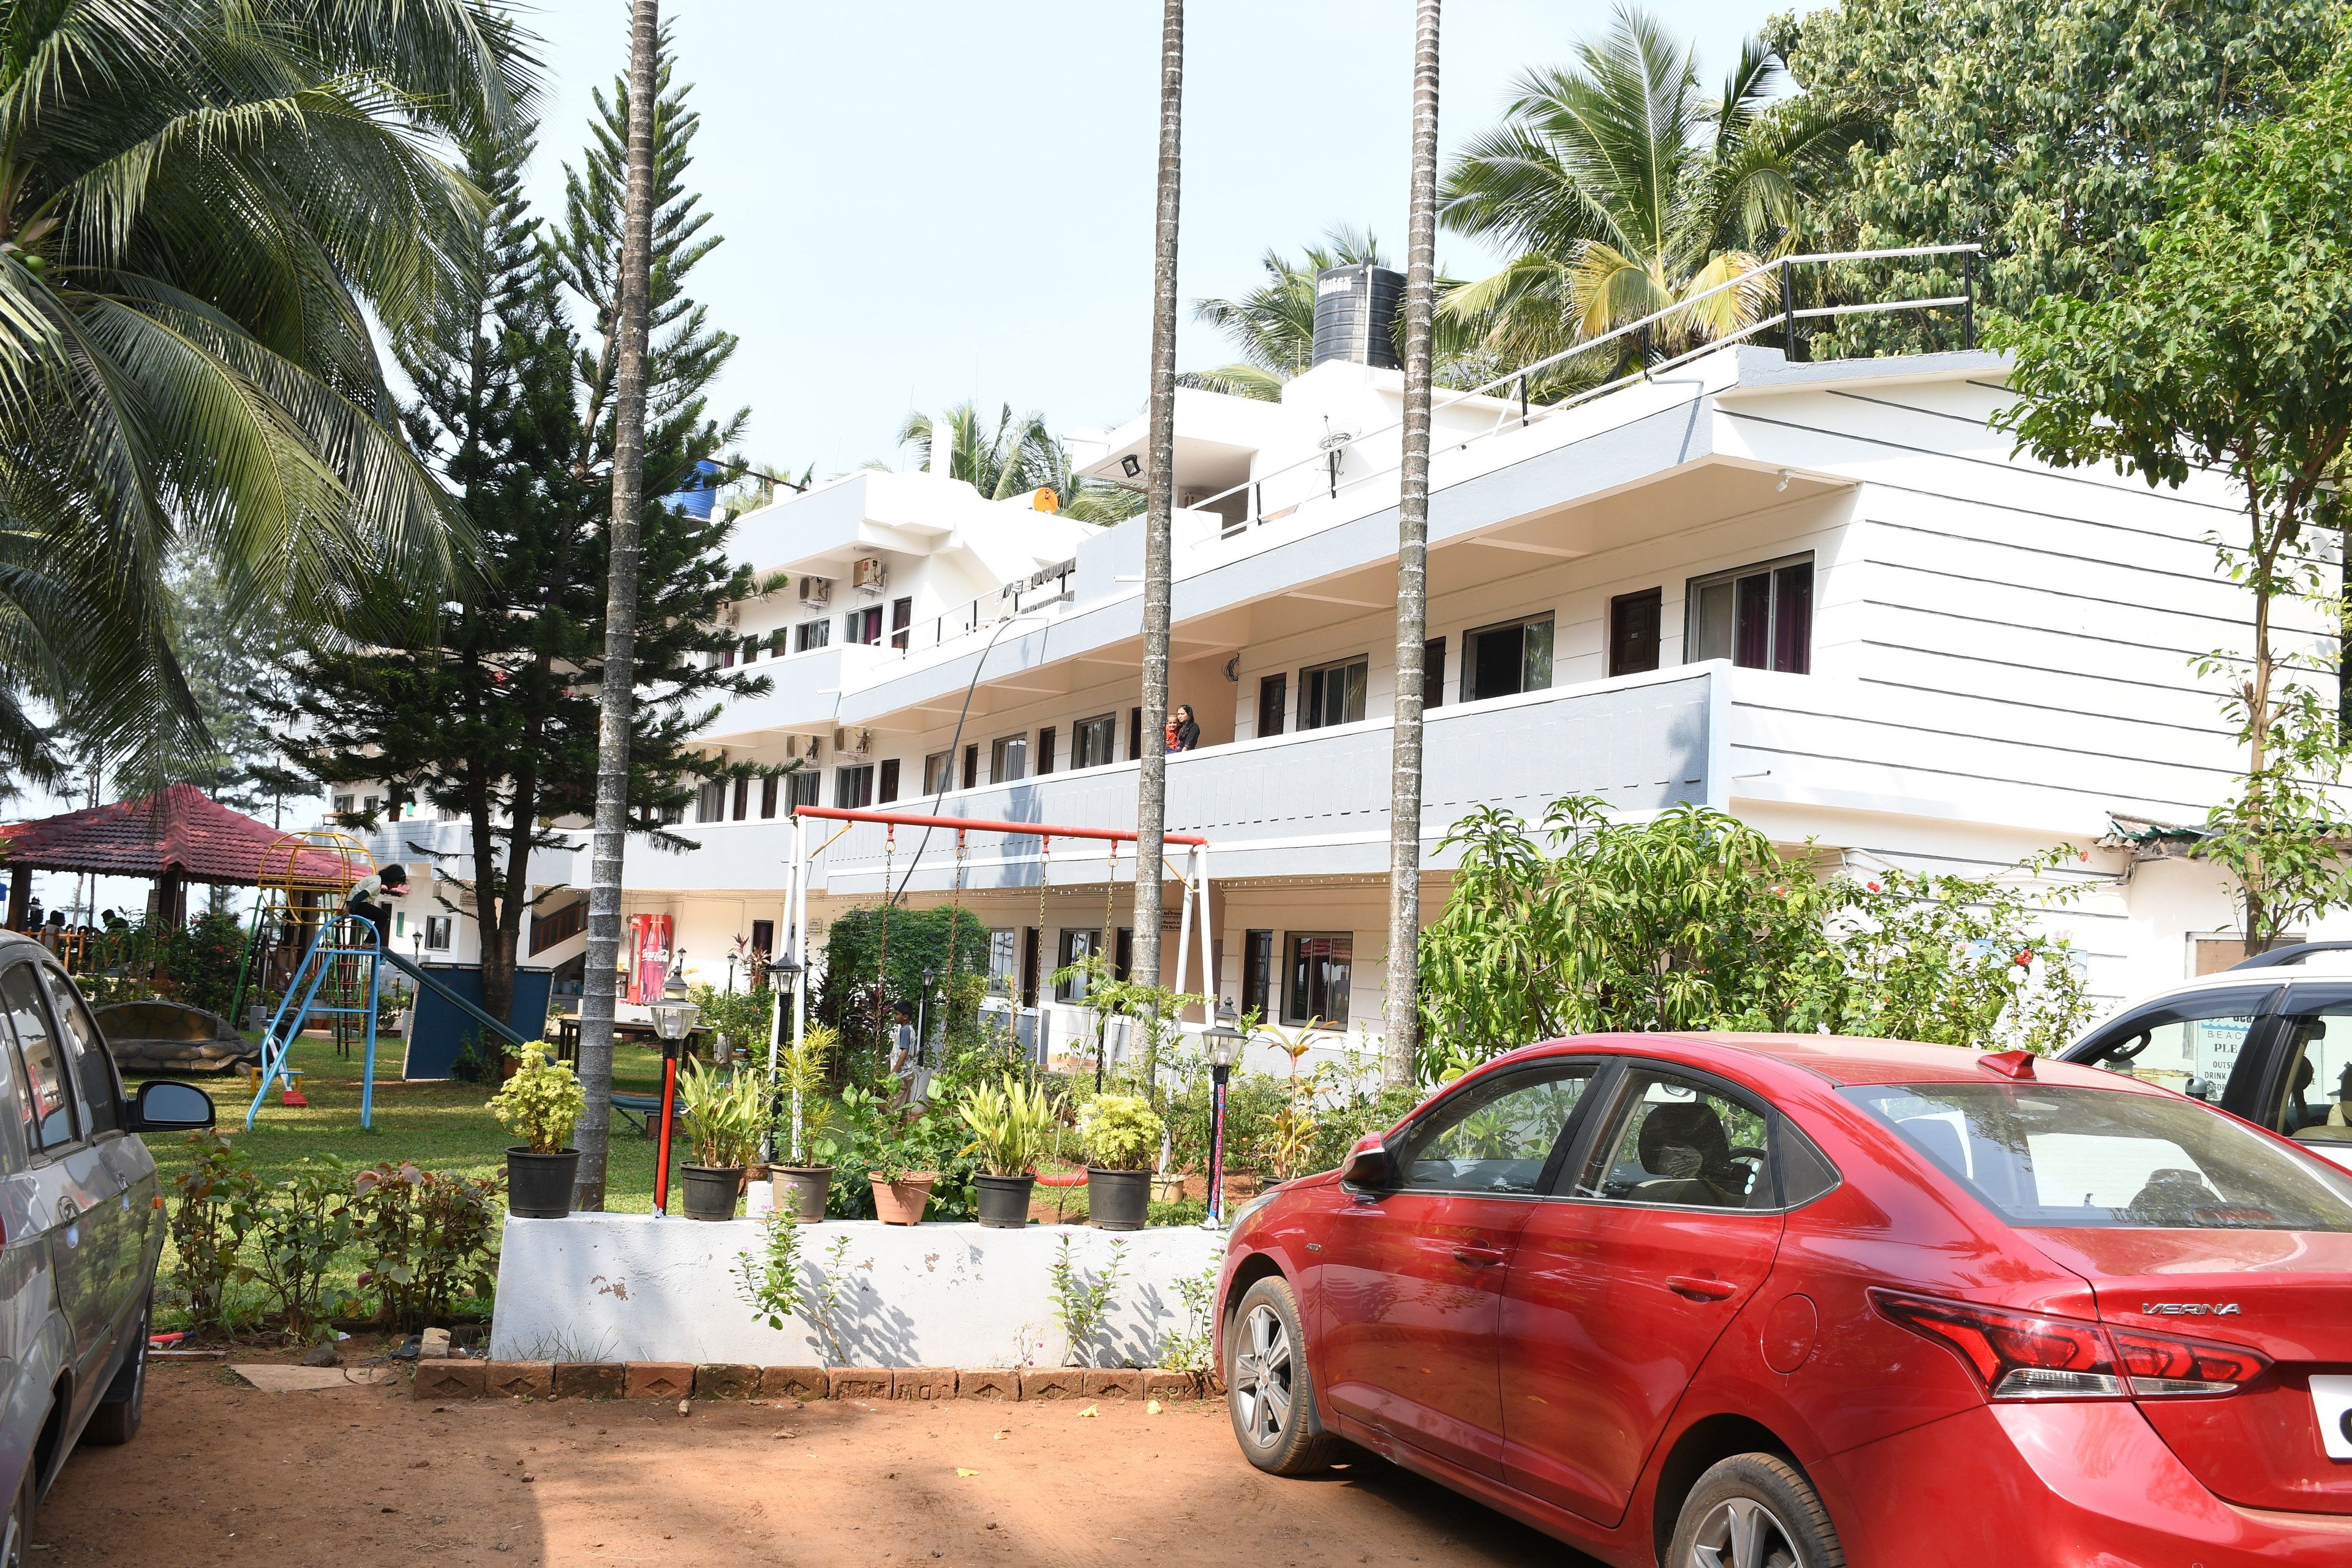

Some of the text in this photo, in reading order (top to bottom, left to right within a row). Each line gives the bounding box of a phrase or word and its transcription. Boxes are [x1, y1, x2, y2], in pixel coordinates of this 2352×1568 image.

[1318, 276, 1352, 297] Sintex
[2205, 1071, 2226, 1080] DRINK
[2143, 1303, 2242, 1315] VERNA
